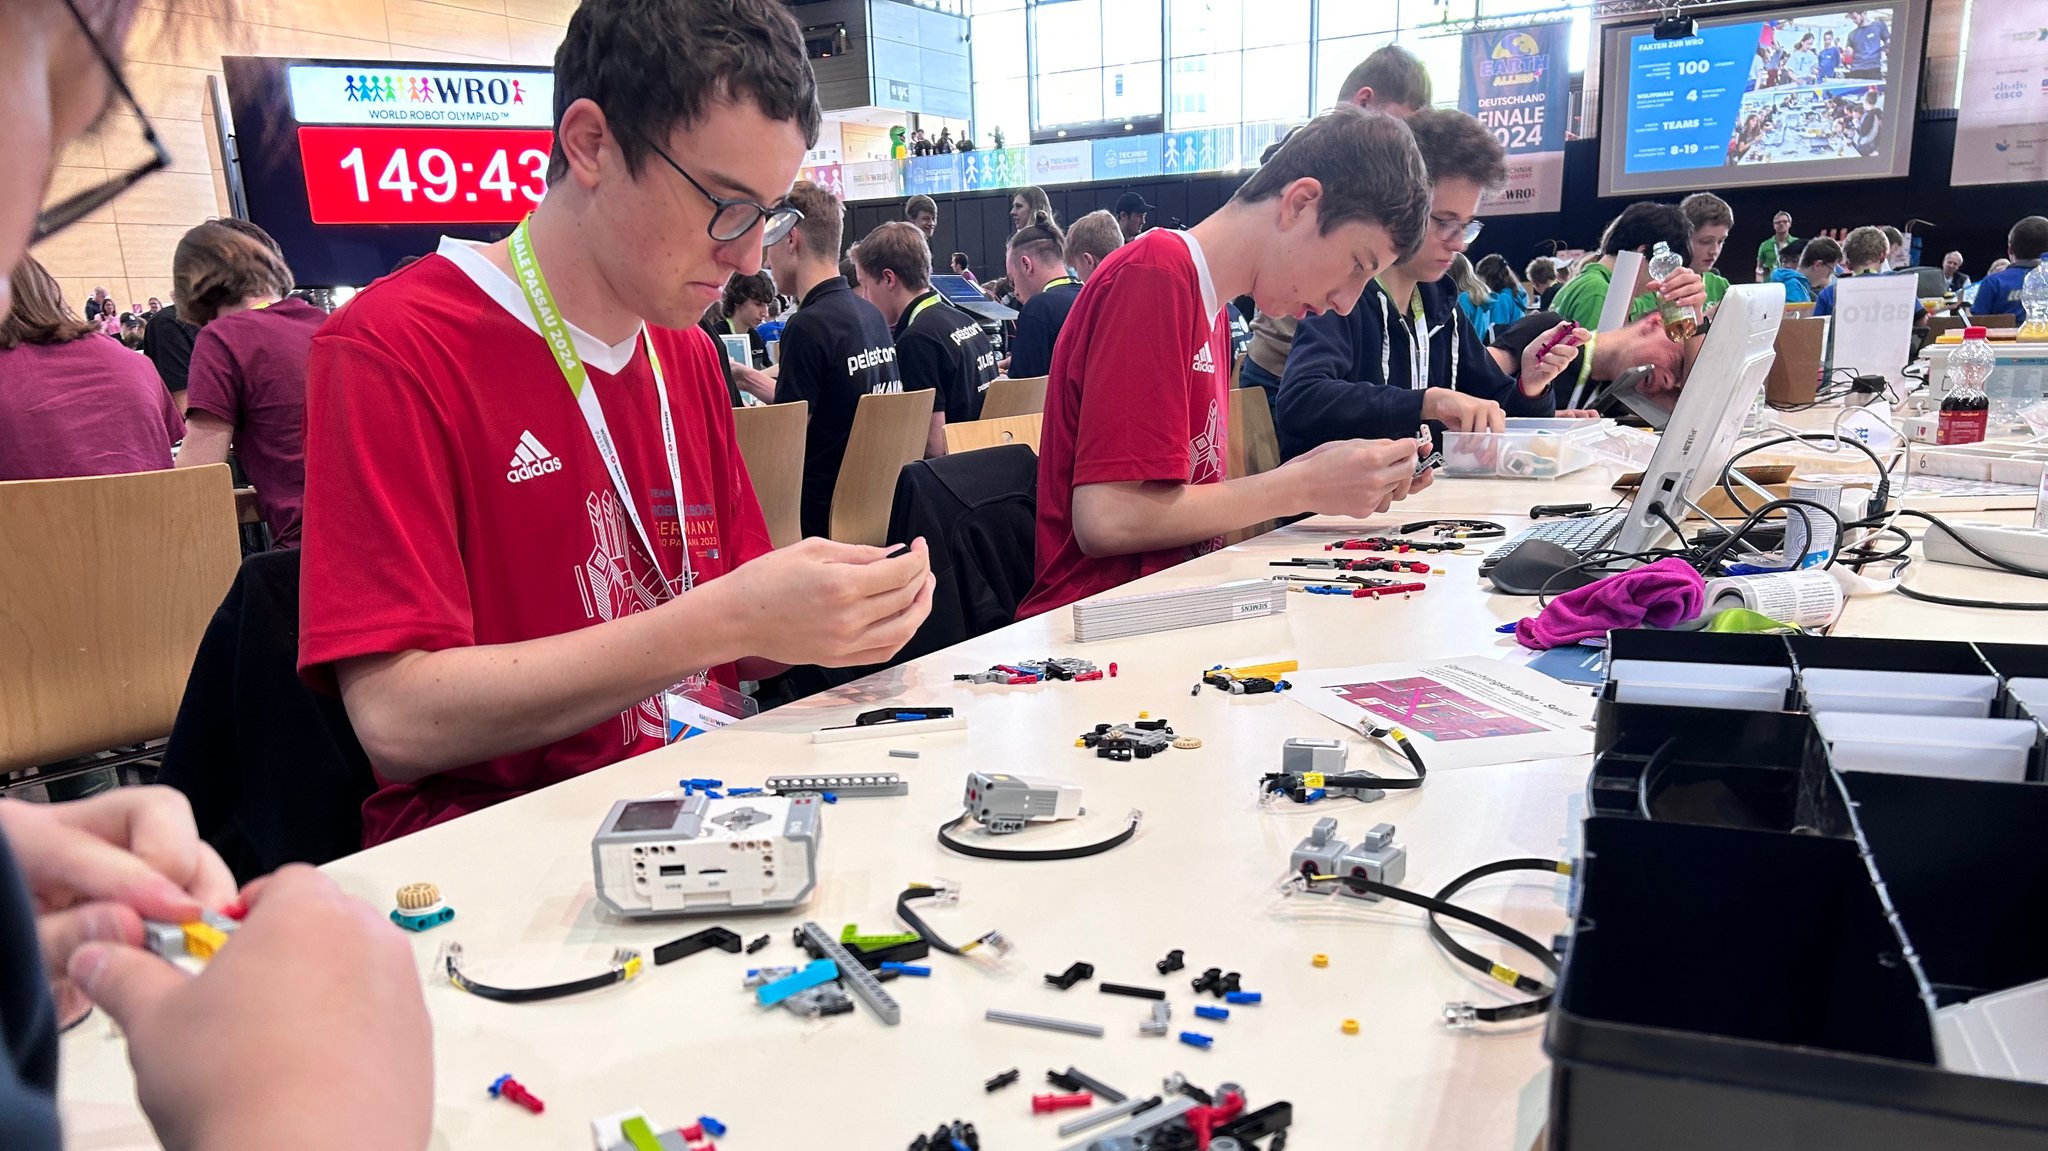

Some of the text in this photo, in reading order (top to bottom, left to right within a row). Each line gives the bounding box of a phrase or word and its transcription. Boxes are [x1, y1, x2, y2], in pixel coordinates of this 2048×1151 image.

[1639, 38, 1704, 51] FAKTEN ZUR WRO
[1480, 54, 1550, 77] EARTH
[1678, 59, 1710, 75] 100
[1478, 93, 1546, 108] DEUTSCHLAND
[1686, 89, 1698, 101] 4
[1994, 91, 2023, 99] CISCO
[368, 110, 407, 120] WORLD
[410, 111, 445, 121] ROBOT
[1478, 107, 1545, 127] FINALE
[1662, 119, 1700, 130] TEAMS
[1490, 124, 1543, 149] 024
[1670, 144, 1699, 155] 8-19
[340, 148, 549, 202] 149:43
[1506, 188, 1532, 200] WRO
[523, 268, 557, 328] PASSAU
[549, 328, 577, 370] 2024
[506, 457, 562, 483] adidas
[701, 537, 717, 546] 2023
